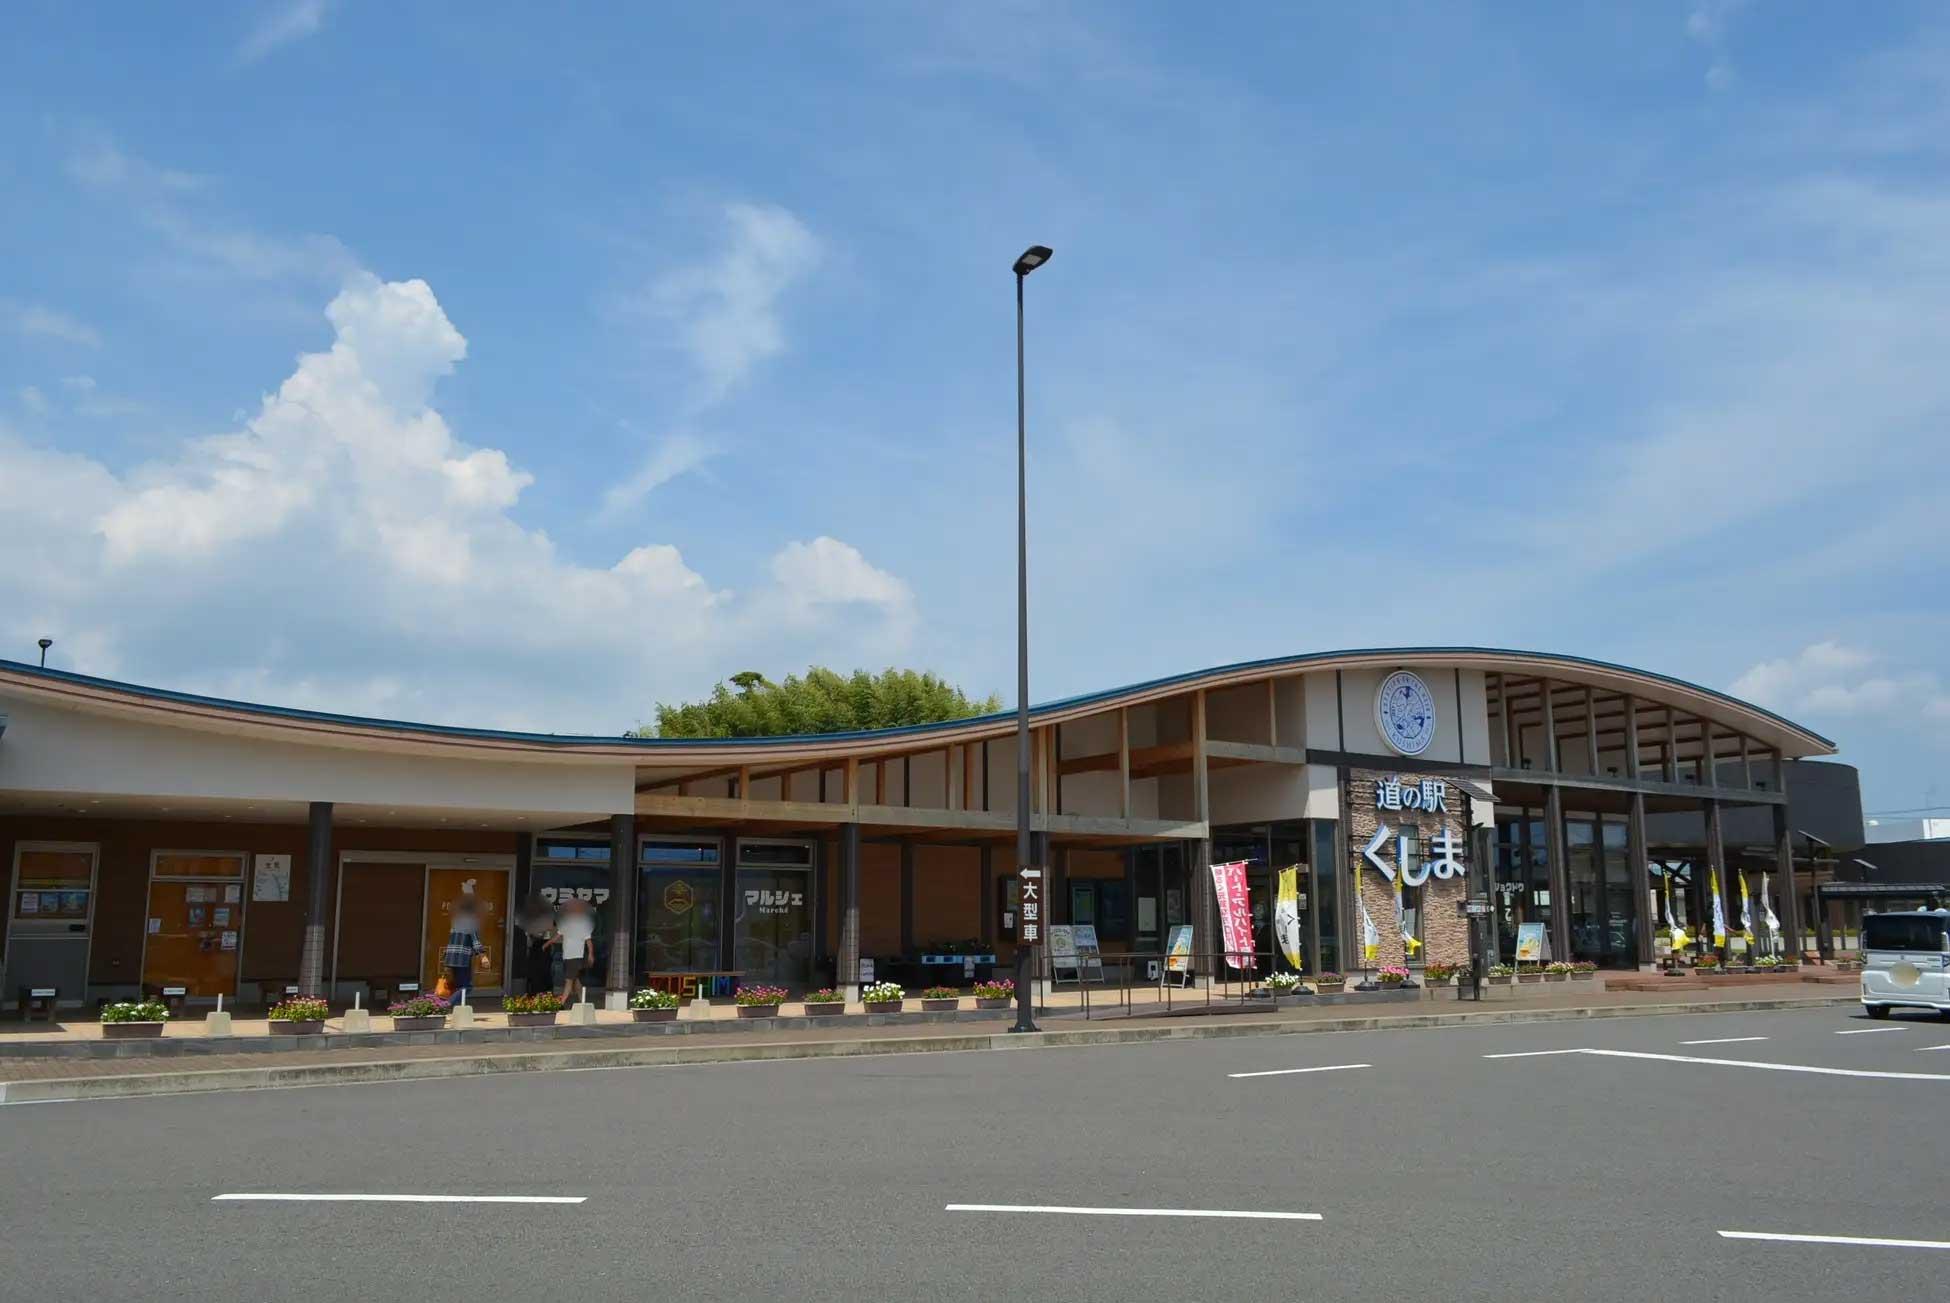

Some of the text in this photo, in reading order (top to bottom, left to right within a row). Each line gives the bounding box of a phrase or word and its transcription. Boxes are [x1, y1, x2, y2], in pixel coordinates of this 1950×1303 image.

[1376, 776, 1448, 813] 道の駅
[1362, 821, 1466, 887] くしま
[744, 889, 804, 906] マルシェ
[1022, 881, 1039, 943] 大型車
[651, 975, 738, 997] KUSHIM
